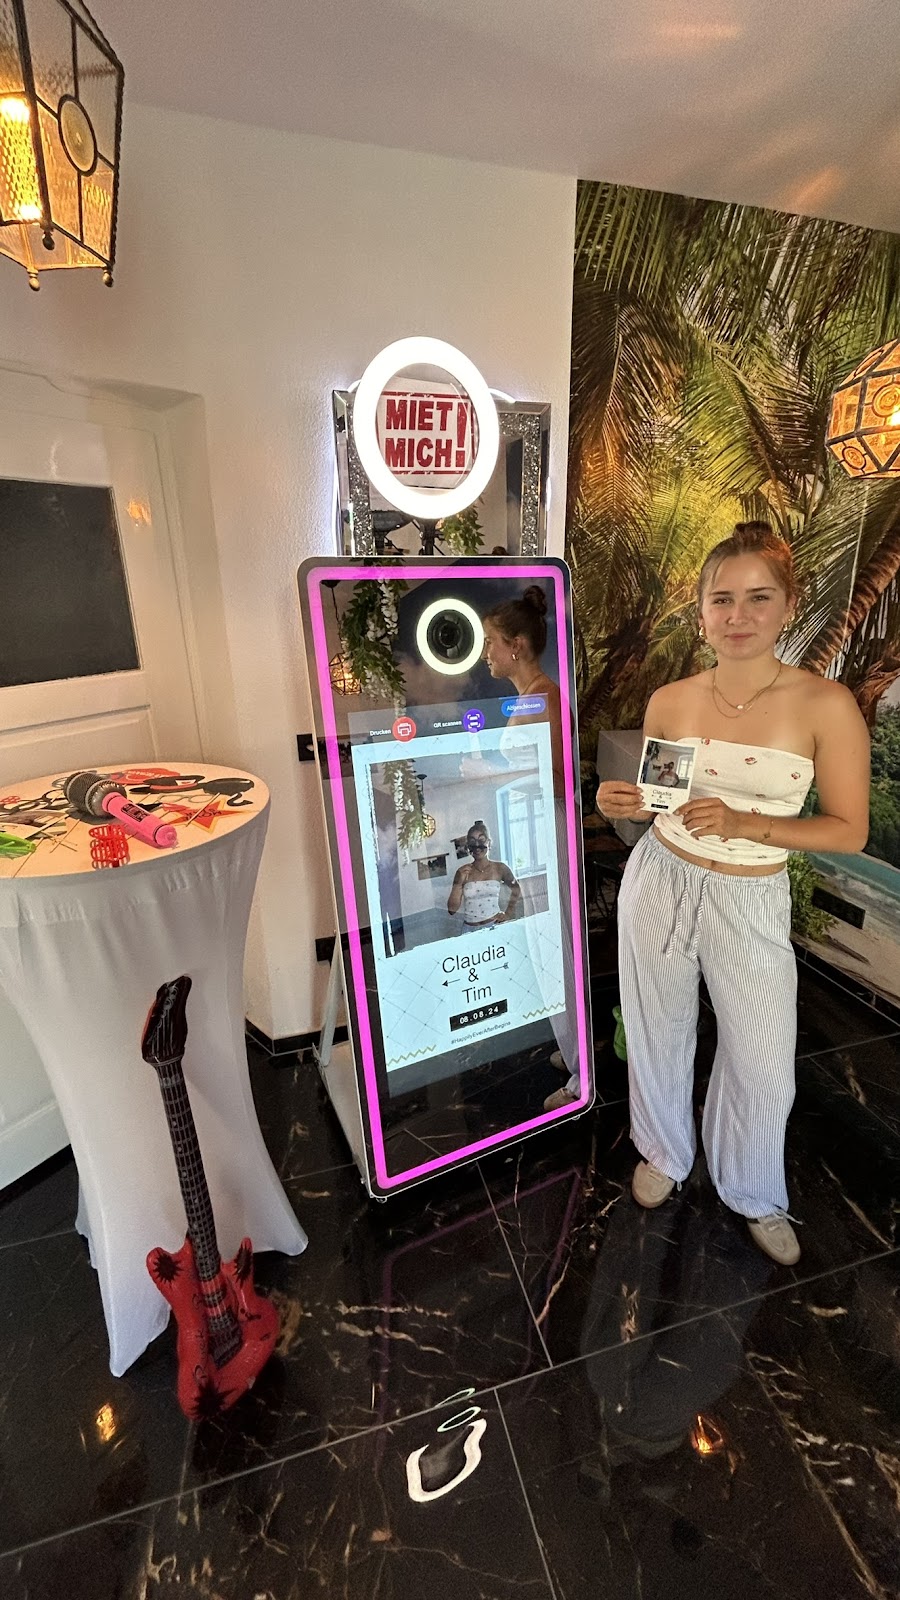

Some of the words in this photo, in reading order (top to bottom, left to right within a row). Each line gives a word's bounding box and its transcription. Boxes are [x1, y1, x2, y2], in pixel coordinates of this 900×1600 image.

[386, 399, 453, 431] MIET
[369, 728, 392, 736] Drucken
[442, 945, 506, 973] Claudia
[467, 967, 479, 983] &
[462, 985, 492, 1003] Tim
